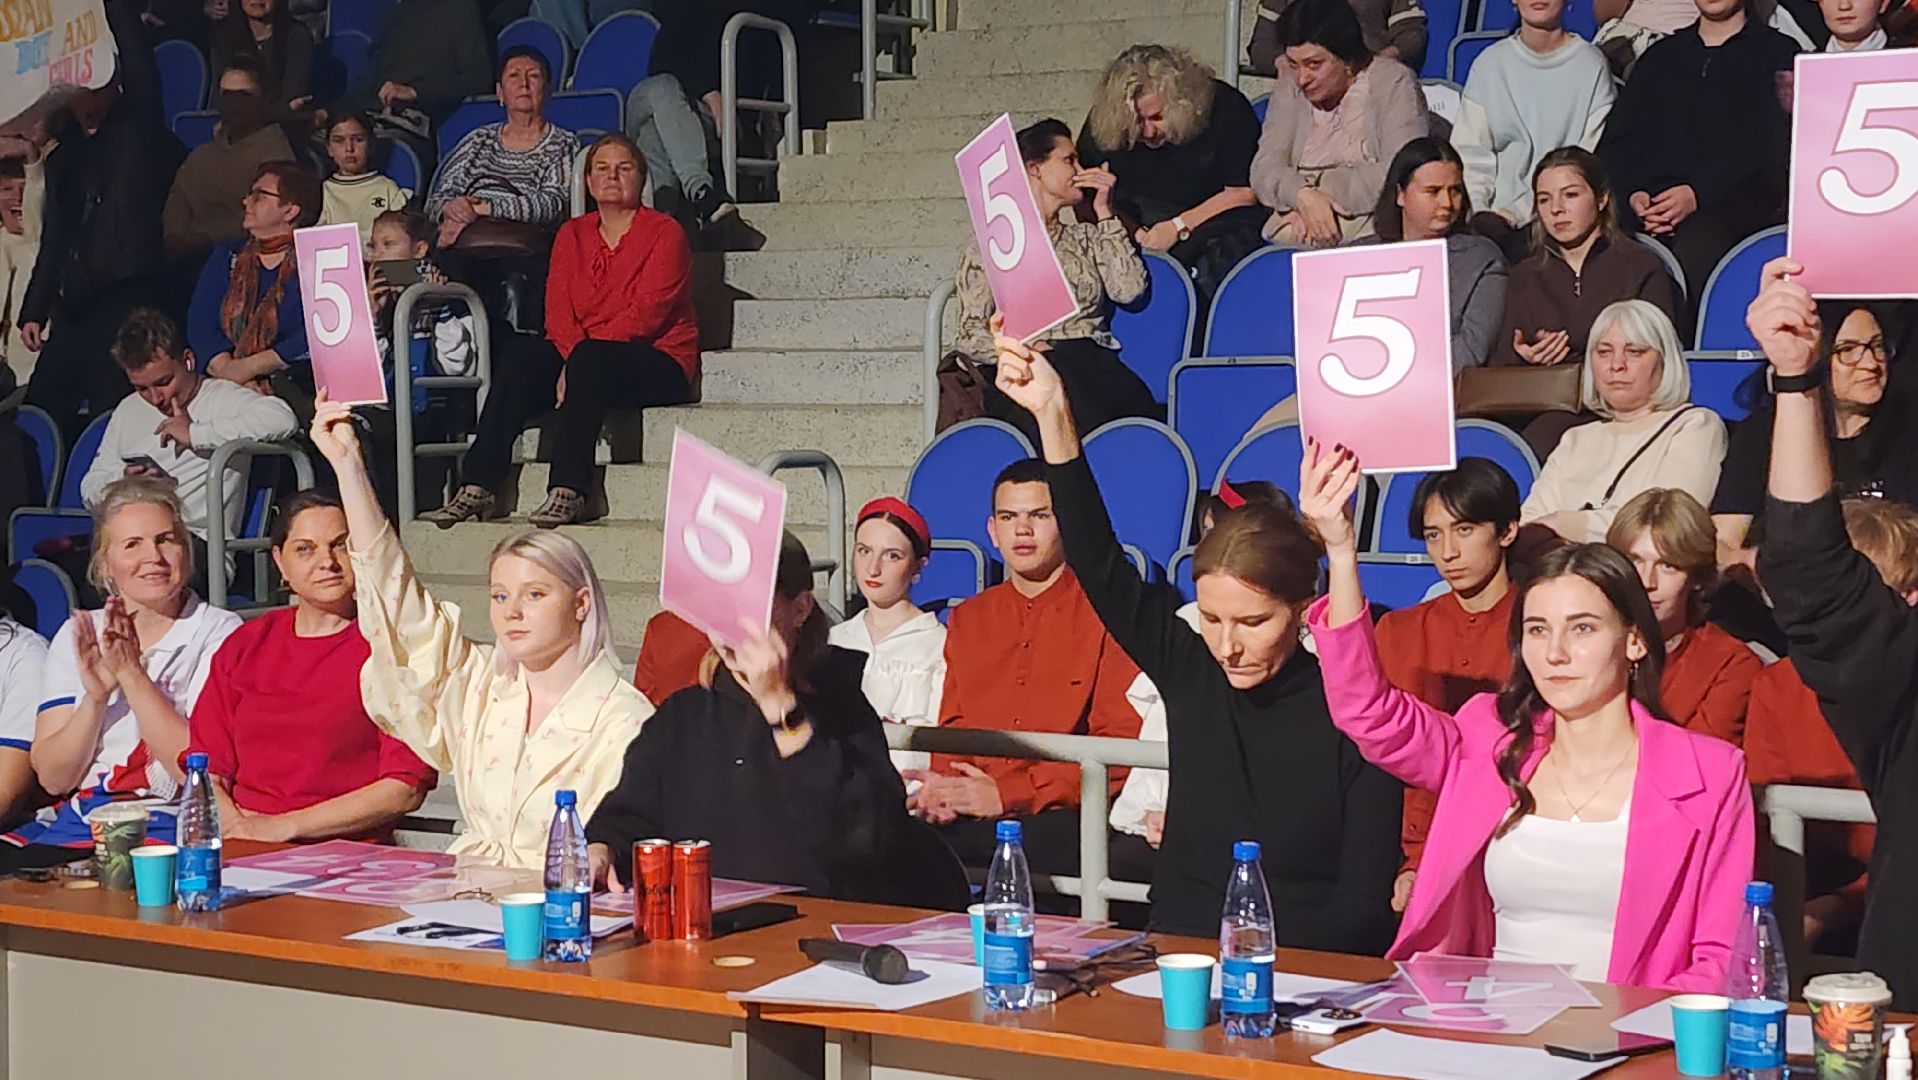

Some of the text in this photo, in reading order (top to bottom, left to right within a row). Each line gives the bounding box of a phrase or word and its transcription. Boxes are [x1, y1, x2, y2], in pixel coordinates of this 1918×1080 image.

[62, 10, 97, 56] AND
[979, 144, 1026, 271] 5
[1819, 81, 1918, 215] 5
[311, 245, 354, 346] 5
[1319, 267, 1422, 398] 5
[682, 472, 766, 584] 5
